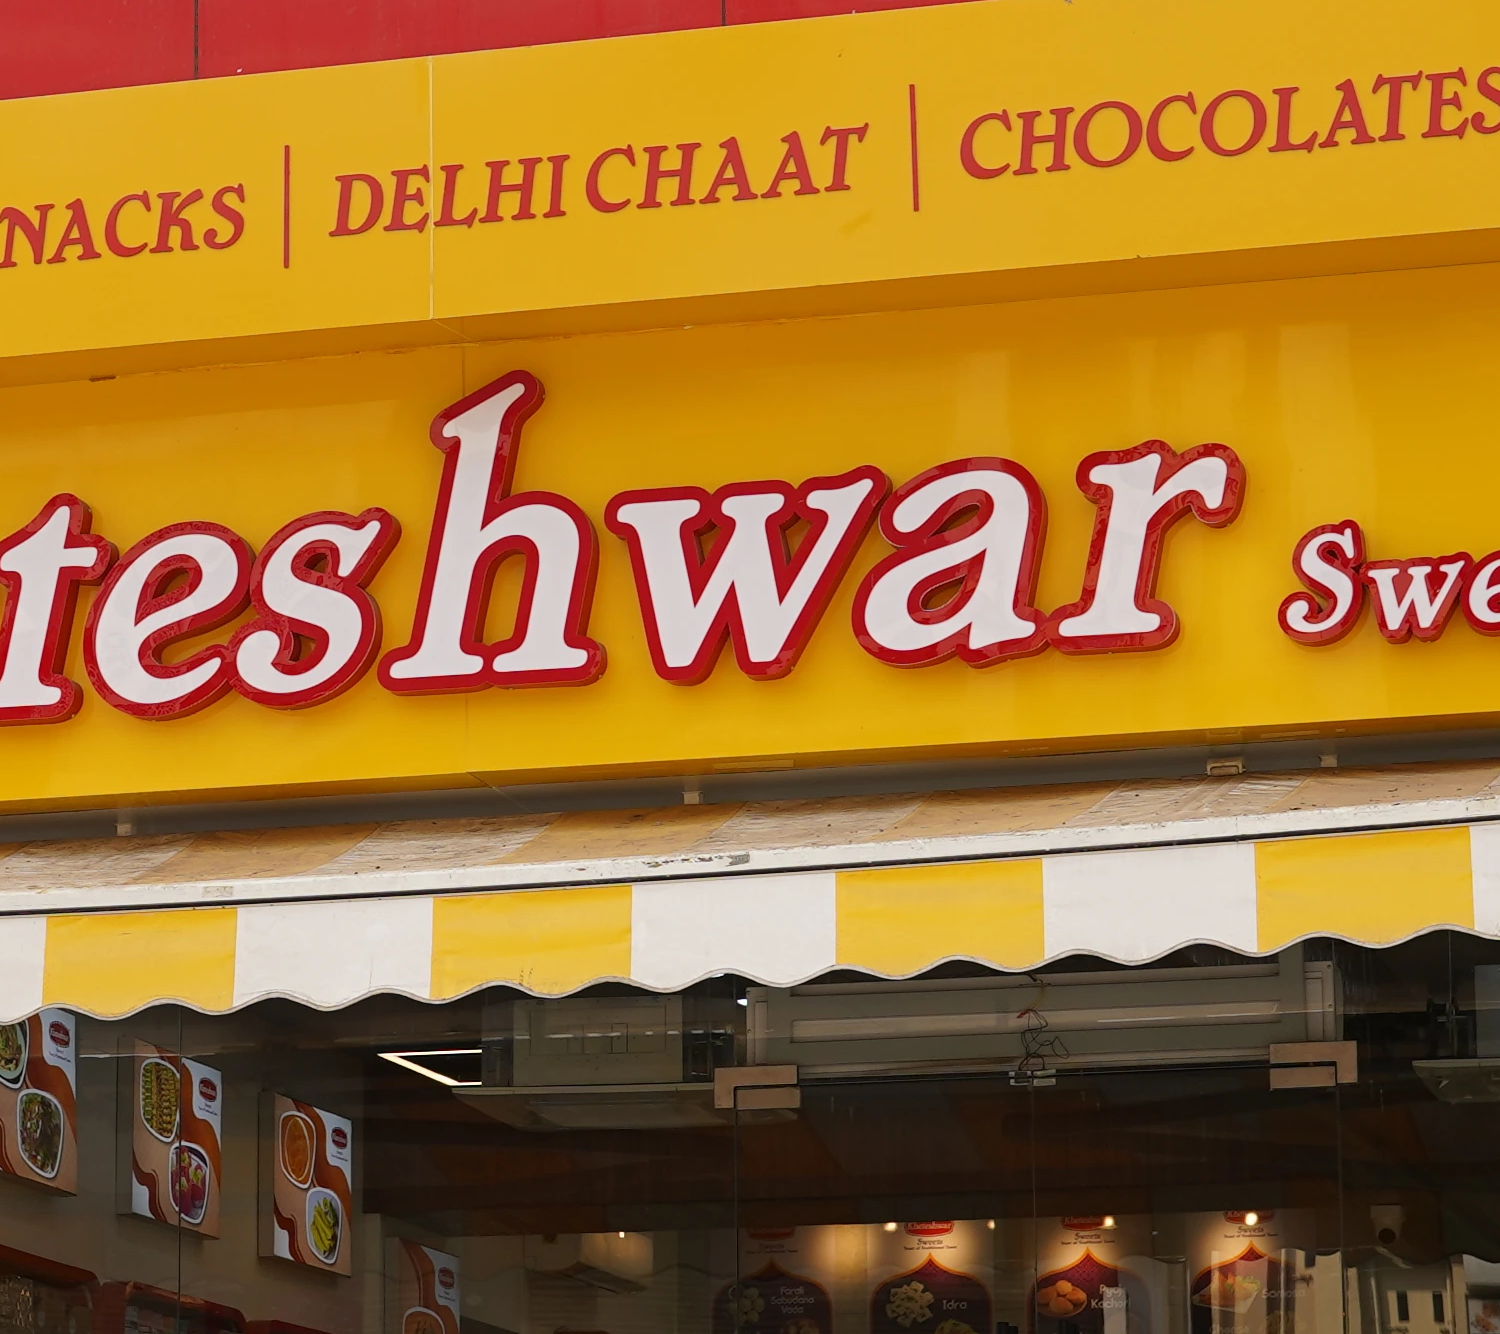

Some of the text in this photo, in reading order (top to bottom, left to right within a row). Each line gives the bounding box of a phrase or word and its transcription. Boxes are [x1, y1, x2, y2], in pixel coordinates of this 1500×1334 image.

[329, 123, 870, 239] DELHI CHAAT
[942, 1299, 968, 1310] Idra
